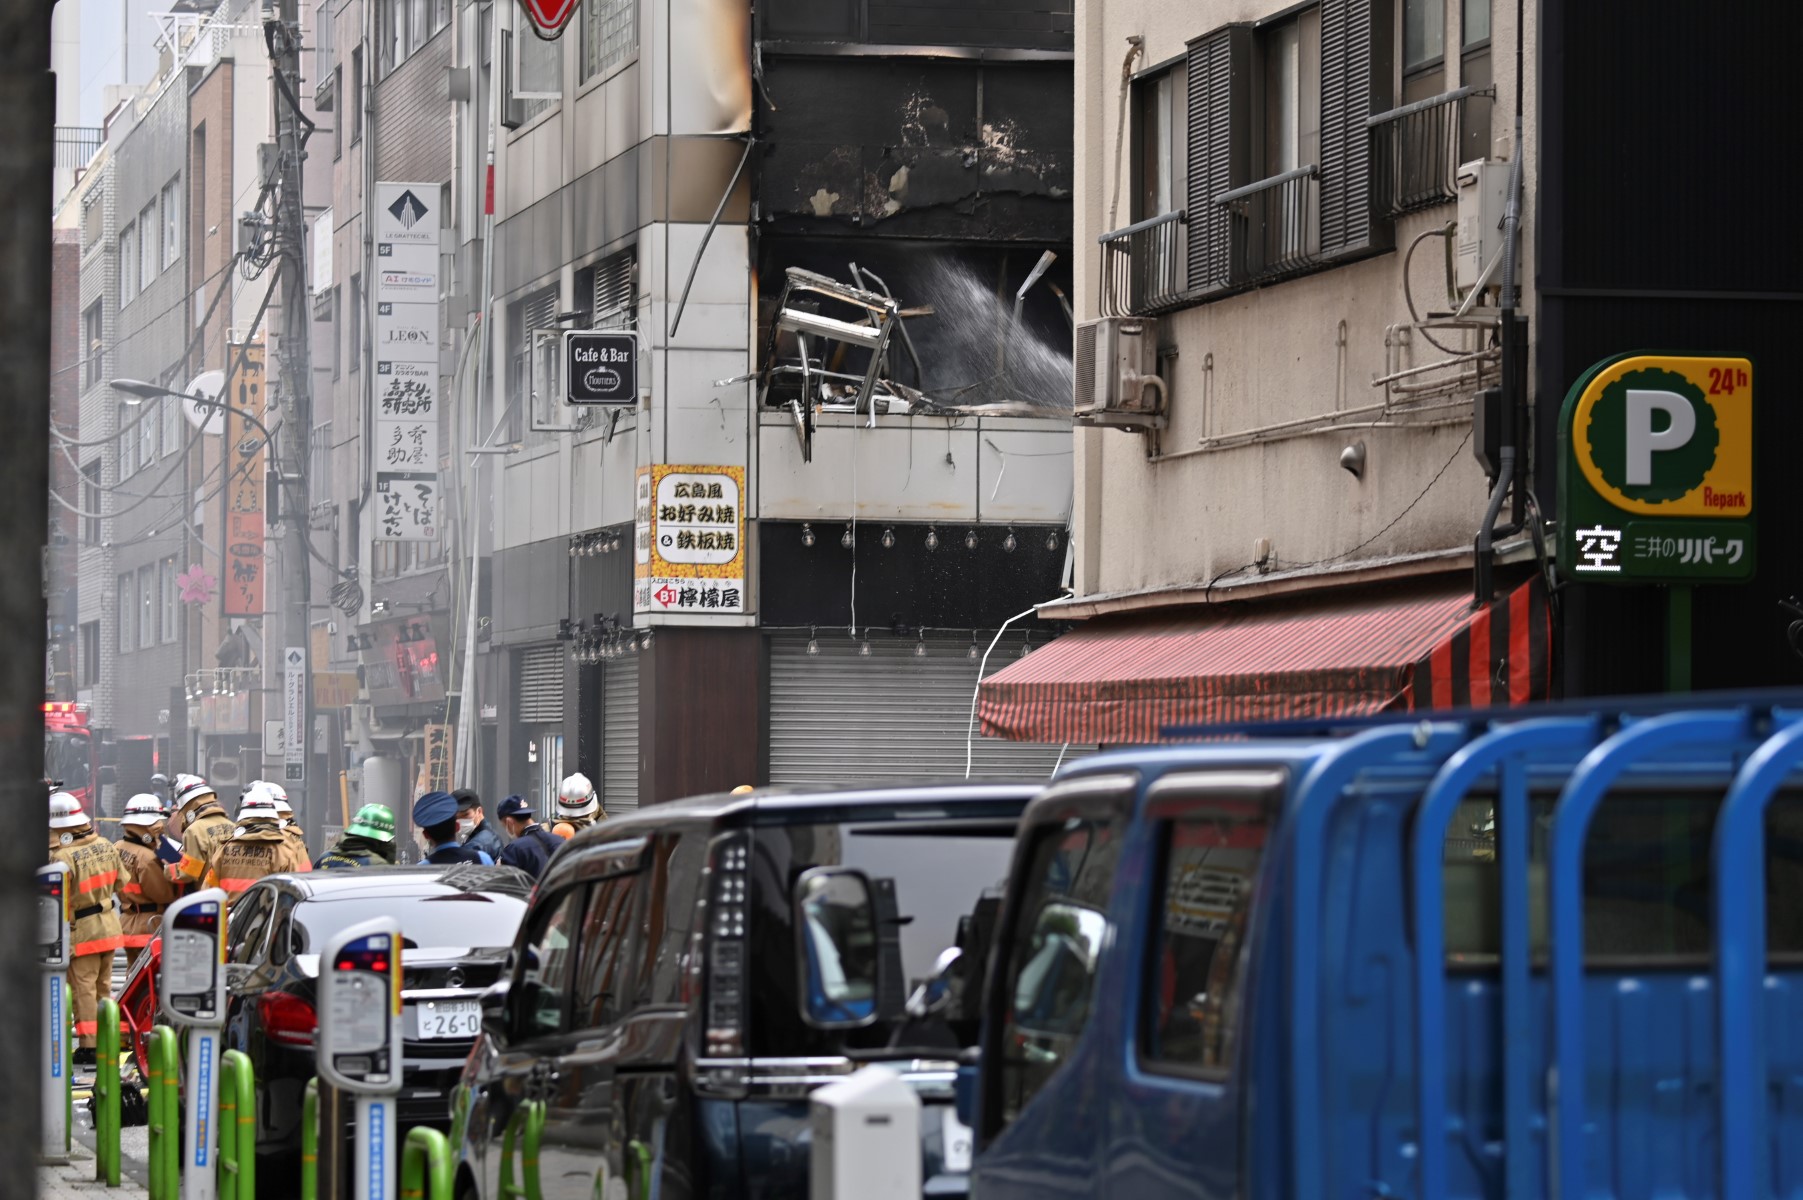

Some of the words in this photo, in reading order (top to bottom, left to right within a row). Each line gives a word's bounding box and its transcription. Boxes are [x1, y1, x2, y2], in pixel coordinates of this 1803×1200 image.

[379, 245, 391, 254] 5F
[379, 305, 391, 313] 4F
[389, 330, 429, 341] LEON
[575, 347, 599, 362] Cafe
[600, 347, 609, 362] &
[610, 347, 629, 362] Bar
[379, 364, 391, 372] 3F
[1708, 367, 1747, 395] 24h
[382, 396, 432, 415] 研究所
[1625, 388, 1696, 486] P
[378, 482, 389, 491] 1F
[673, 482, 723, 499] 広島風
[404, 502, 412, 513] と
[413, 483, 434, 526] そば
[1704, 486, 1746, 510] Repark
[382, 491, 403, 537] けんちん
[659, 504, 735, 524] お好み焼
[676, 530, 735, 551] 鉄板焼
[1575, 524, 1622, 572] 空
[1633, 535, 1744, 565] 三井のリパーク
[660, 590, 675, 602] B1
[678, 586, 740, 608] 檸檬屋
[321, 855, 361, 869] METROPOLITA
[435, 1014, 479, 1034] 26-0
